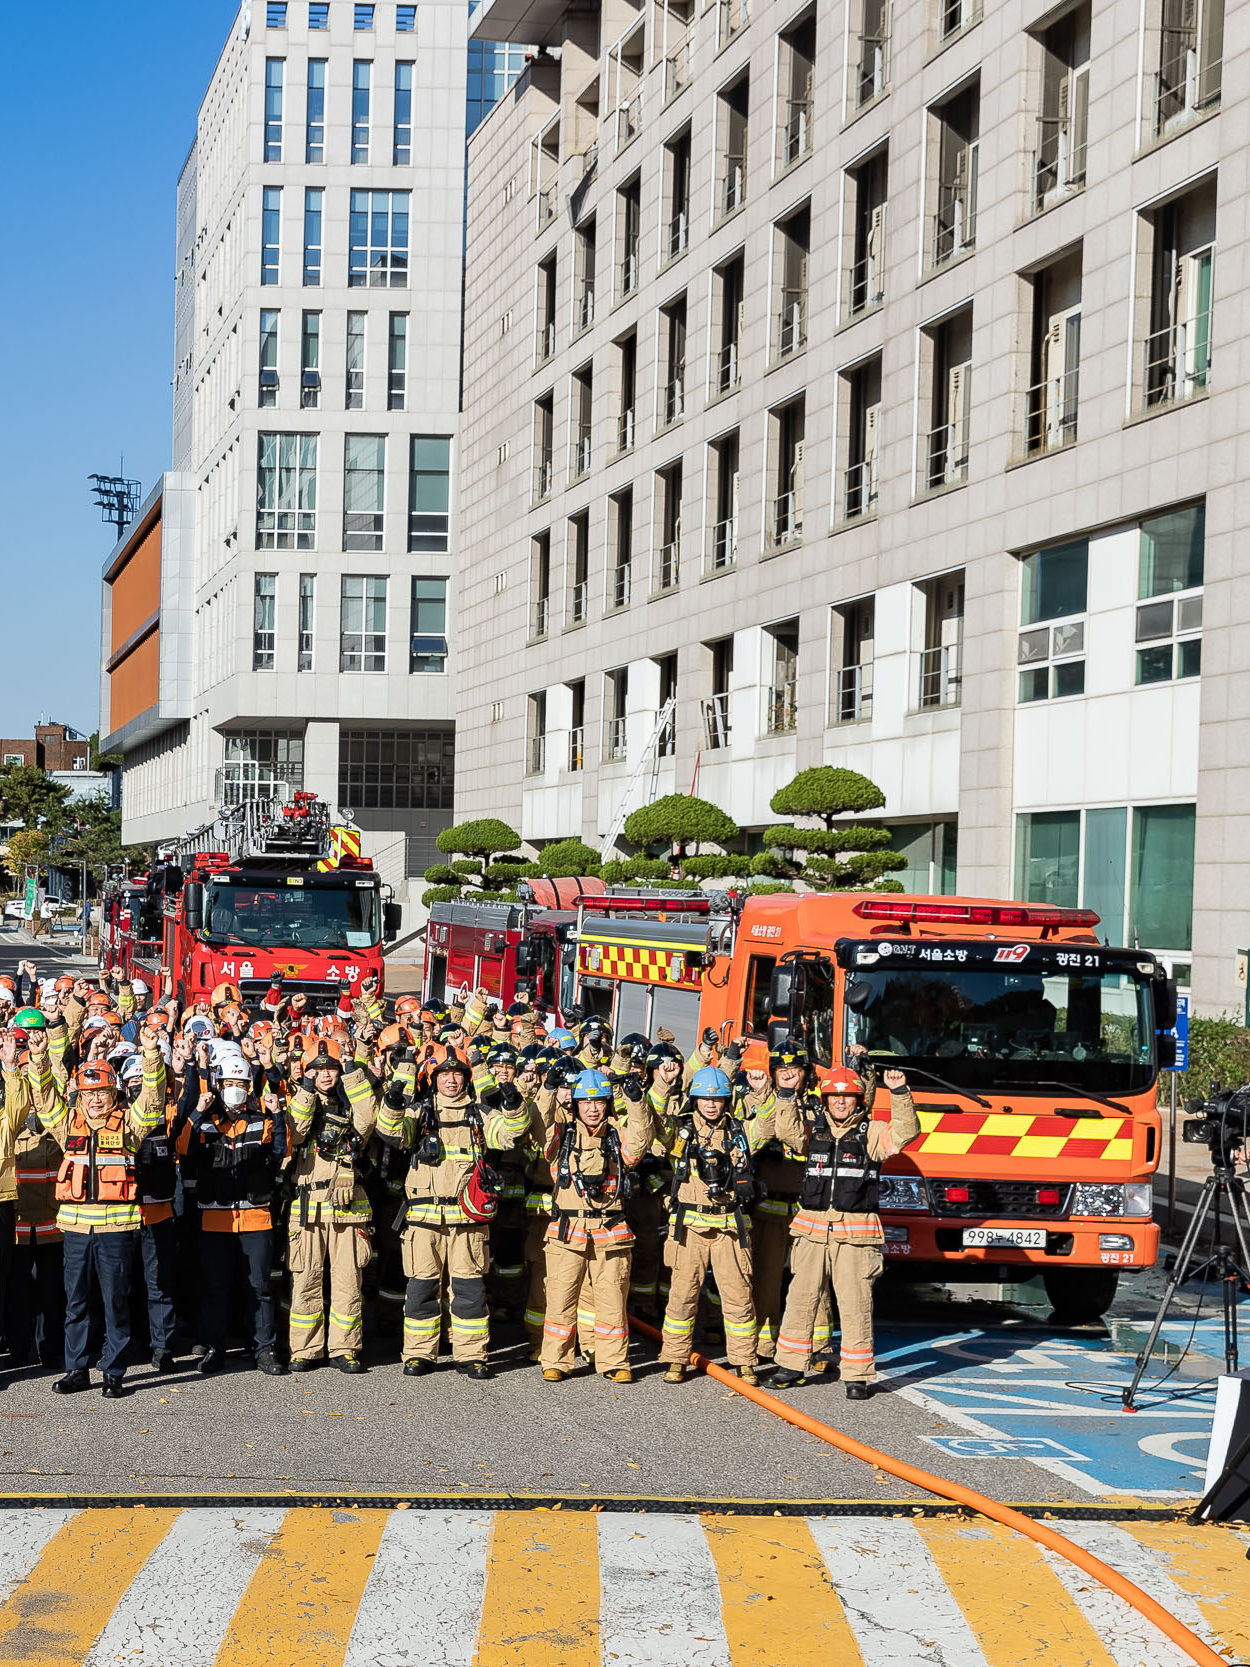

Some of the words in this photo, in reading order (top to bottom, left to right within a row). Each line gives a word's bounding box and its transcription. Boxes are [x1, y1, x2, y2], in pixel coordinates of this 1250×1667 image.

[919, 948, 968, 962] 서울소방
[997, 946, 1028, 961] 119
[1056, 952, 1081, 967] 광진
[1084, 955, 1100, 967] 21
[220, 961, 254, 978] 서울
[325, 964, 360, 983] 소방
[67, 1136, 84, 1149] 119
[967, 1230, 1041, 1245] 998누4842
[1100, 1252, 1120, 1264] 광진
[1122, 1253, 1134, 1264] 21
